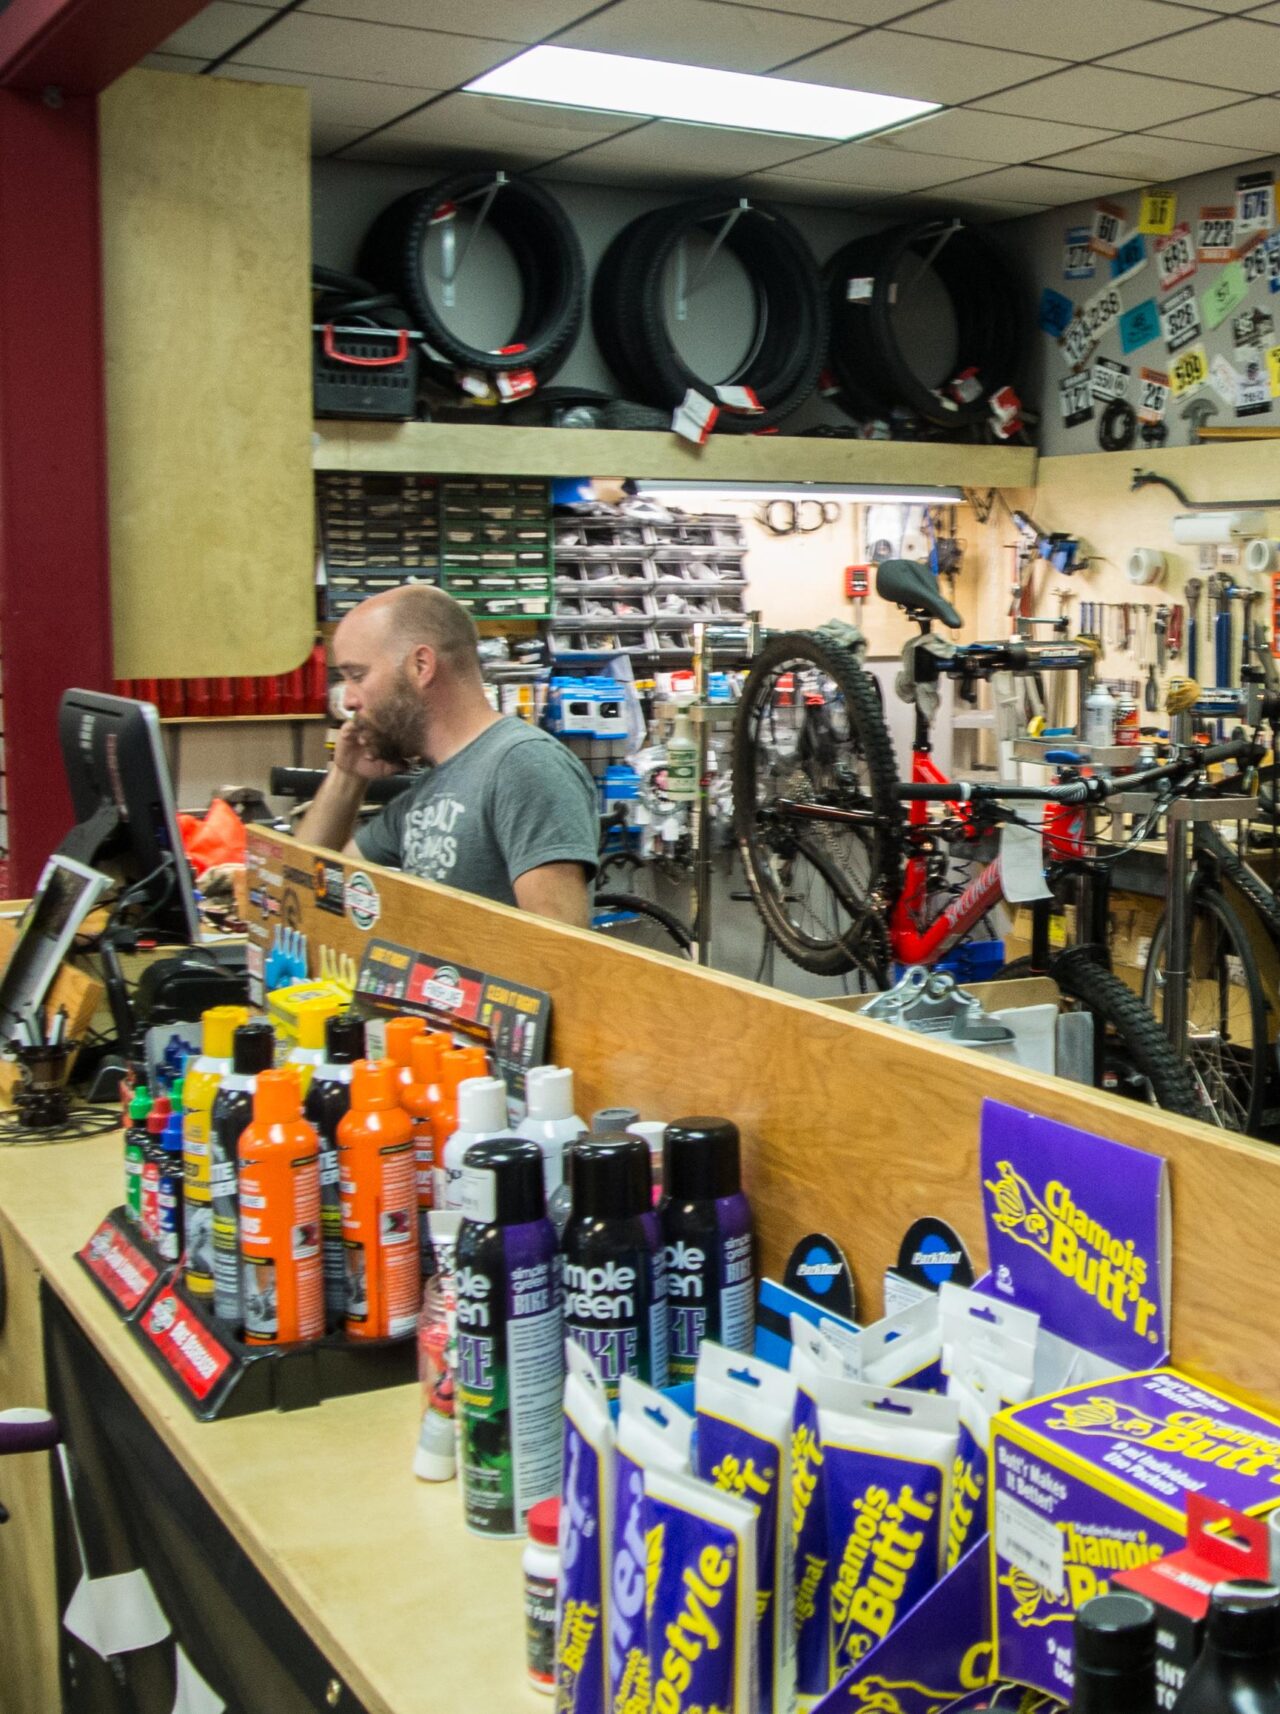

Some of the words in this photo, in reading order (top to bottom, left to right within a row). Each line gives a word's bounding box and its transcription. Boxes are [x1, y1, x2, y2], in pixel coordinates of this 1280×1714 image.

[1045, 1181, 1148, 1285] Chamois
[1050, 1219, 1157, 1338] Butt'r
[831, 1484, 889, 1625] Chamois
[849, 1484, 935, 1641] Butt'r
